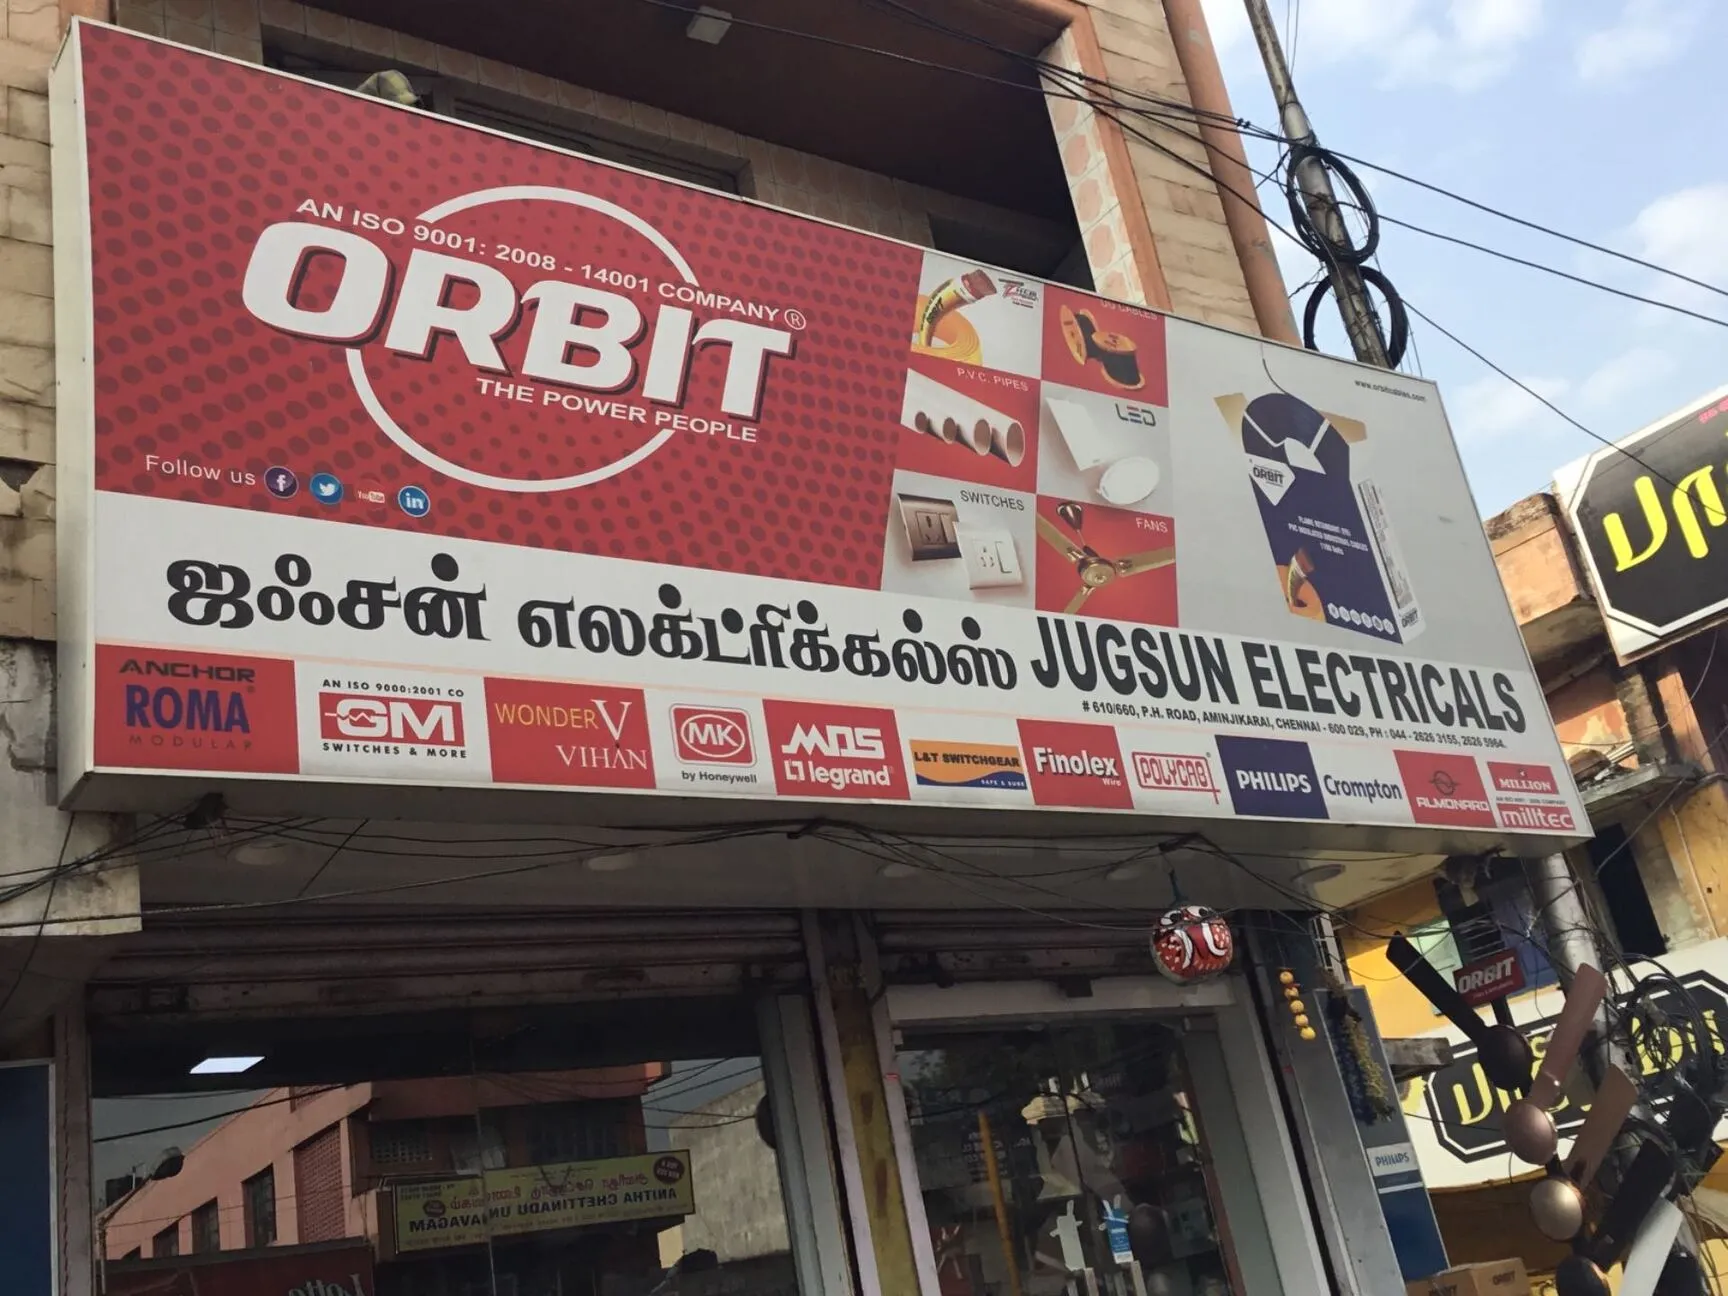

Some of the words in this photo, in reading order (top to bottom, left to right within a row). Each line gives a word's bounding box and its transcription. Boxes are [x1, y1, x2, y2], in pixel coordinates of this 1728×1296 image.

[296, 198, 343, 222] AN
[353, 210, 405, 235] ISO
[413, 225, 486, 256] 9001:
[494, 244, 556, 271] 2008
[580, 264, 650, 293] 14001
[658, 282, 780, 322] COMPANY
[242, 221, 796, 420] ORBIT
[957, 367, 991, 384] P.V.C.
[993, 374, 1029, 392] PIPES
[476, 377, 534, 404] THE
[543, 390, 648, 424] POWER
[655, 411, 758, 443] PEOPLE
[1114, 402, 1156, 427] LED
[145, 454, 221, 481] Follow
[230, 468, 256, 485] us
[1252, 466, 1284, 486] ORBIT
[960, 489, 1025, 512] SWITCHES
[1136, 517, 1168, 534] FANS
[517, 583, 1018, 691] எலக்ட்ரிக்கல்ஸ்
[119, 658, 256, 683] ANCHOR
[1030, 616, 1240, 705] JUGSUN
[1241, 641, 1527, 734] ELECTRICALS
[322, 678, 341, 689] AN
[348, 681, 369, 691] ISO
[375, 683, 441, 697] 9000:2001
[448, 688, 464, 698] CO
[125, 684, 250, 734] ROMA
[325, 698, 457, 742] GM
[494, 702, 598, 730] WONDER
[591, 699, 633, 742] V
[1082, 701, 1090, 713] #
[1093, 702, 1140, 719] 610/660,
[1141, 705, 1164, 720] P.H.
[1166, 707, 1200, 723] ROAD,
[1203, 711, 1274, 730] AMINJIKARAI,
[1276, 717, 1321, 733] CHENNAI
[1327, 722, 1346, 735] 600
[1369, 726, 1384, 739] PH
[129, 734, 253, 751] MODULAR
[686, 721, 740, 748] MK
[322, 742, 400, 756] SWITCHES
[409, 747, 418, 757] &
[427, 748, 468, 759] MORE
[555, 744, 649, 771] VIHAN
[914, 751, 939, 764] L&T
[942, 752, 1020, 768] SWITCHGEAR
[1033, 747, 1120, 778] Finolex
[681, 770, 696, 783] by
[699, 770, 758, 784] Honeywell
[810, 760, 892, 791] legrand
[1139, 757, 1209, 790] POLYCAB
[1236, 769, 1312, 794] PHILIPS
[1324, 774, 1402, 804] Crompton
[1416, 796, 1490, 812] ALMONARD
[1501, 806, 1574, 829] milltec
[1458, 955, 1516, 995] ORBIT
